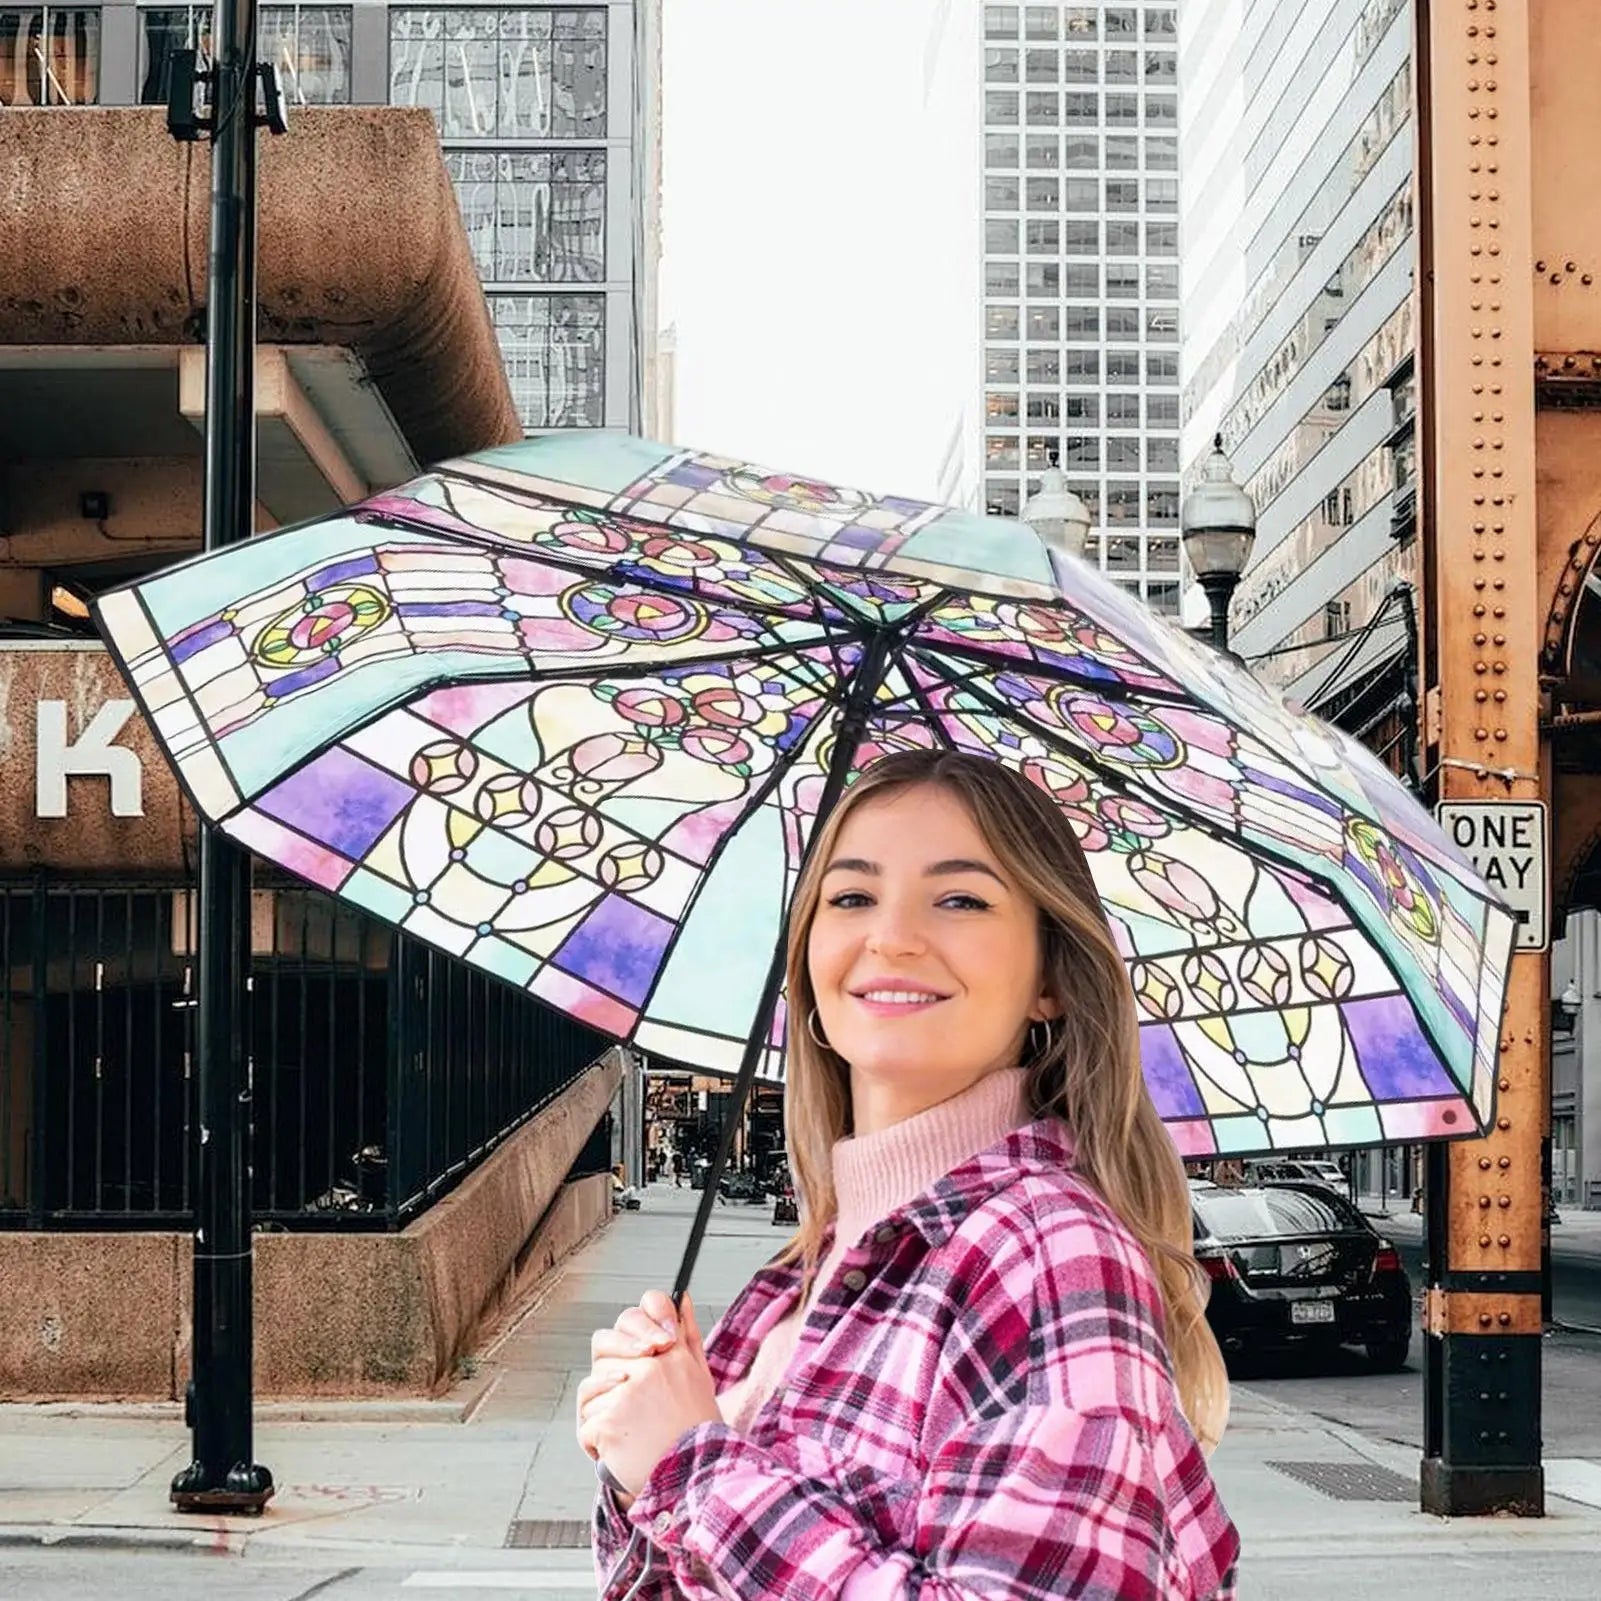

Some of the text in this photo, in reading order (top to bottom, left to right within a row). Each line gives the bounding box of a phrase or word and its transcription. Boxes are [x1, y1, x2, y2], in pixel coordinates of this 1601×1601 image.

[37, 699, 145, 817] K
[1453, 815, 1533, 848] ONE
[1472, 856, 1533, 889] AY
